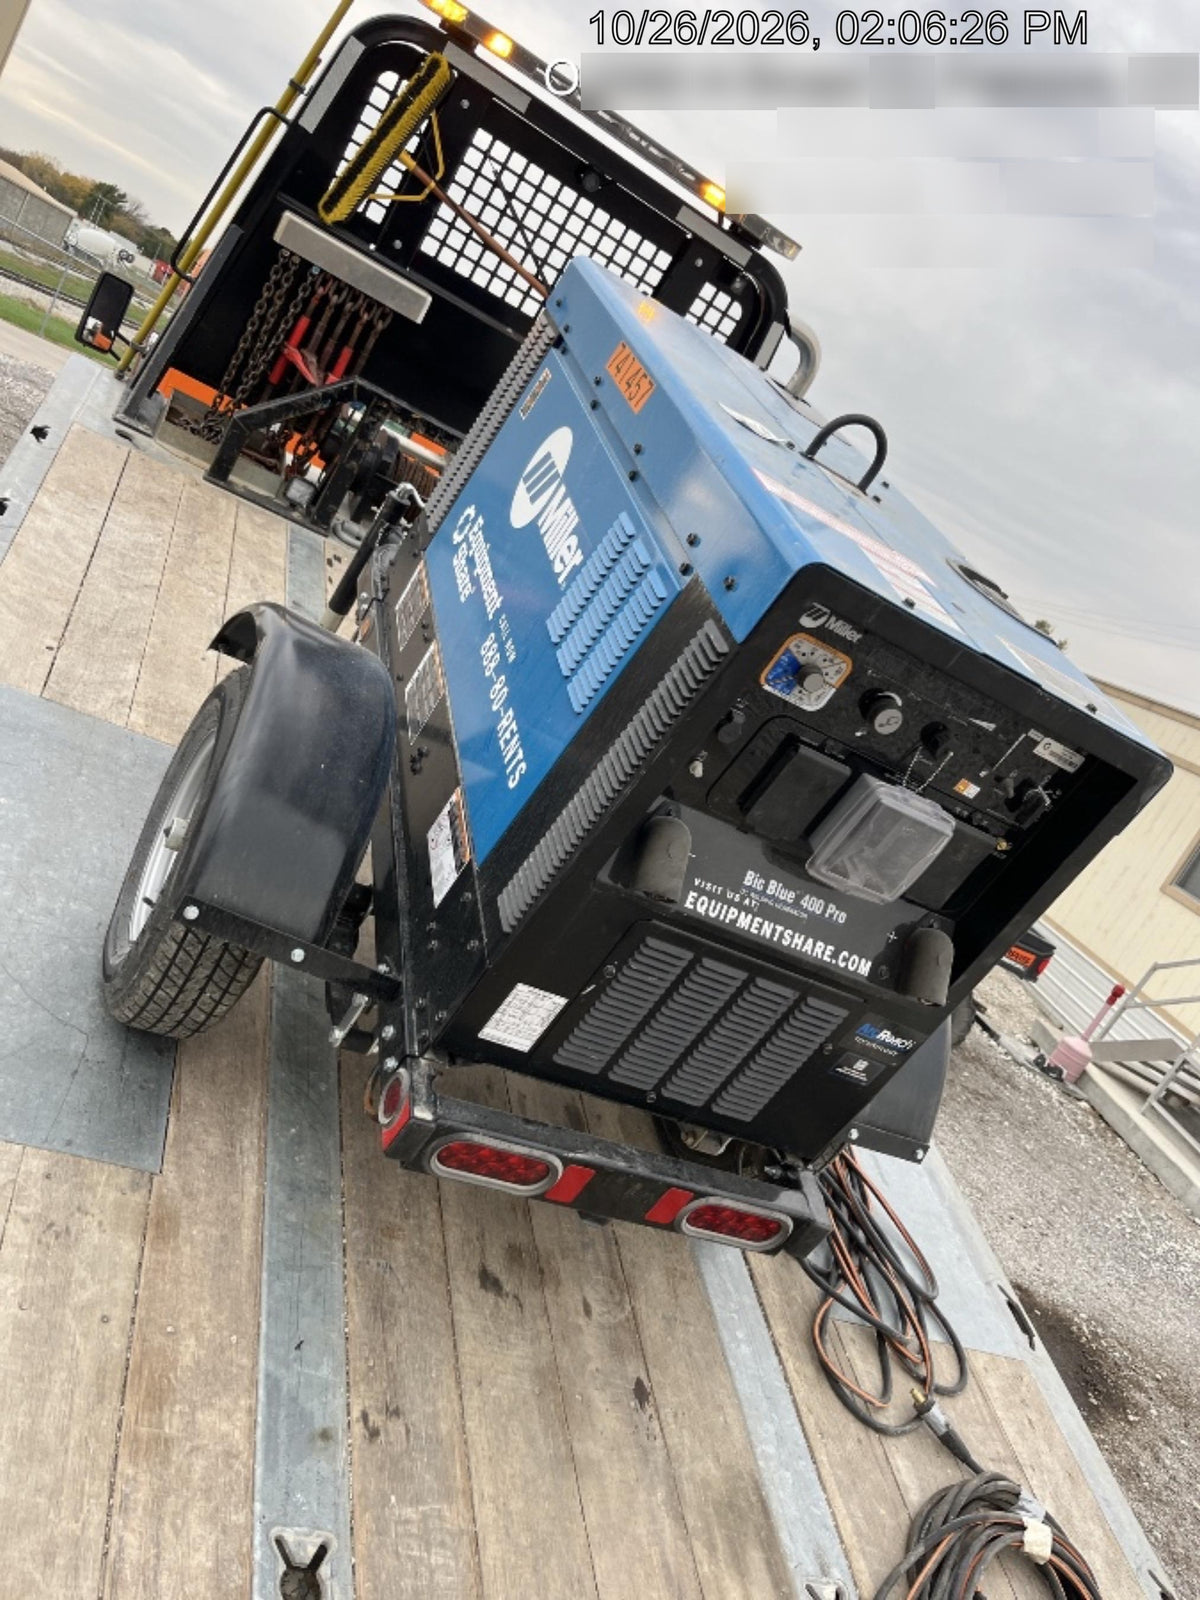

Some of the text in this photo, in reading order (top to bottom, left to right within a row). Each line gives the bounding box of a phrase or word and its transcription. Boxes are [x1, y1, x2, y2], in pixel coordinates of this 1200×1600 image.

[608, 342, 655, 407] 741457
[468, 514, 504, 621] Equipment
[538, 483, 584, 587] Miller
[453, 542, 476, 603] Share
[824, 615, 863, 643] Miller
[480, 632, 527, 790] 888-80-RENTS
[693, 877, 724, 896] VISIT
[727, 888, 742, 903] US
[766, 879, 797, 904] Blue
[800, 892, 825, 915] 400
[824, 902, 848, 925] Pro
[684, 890, 872, 978] EQUIPMENTSHARE.COM
